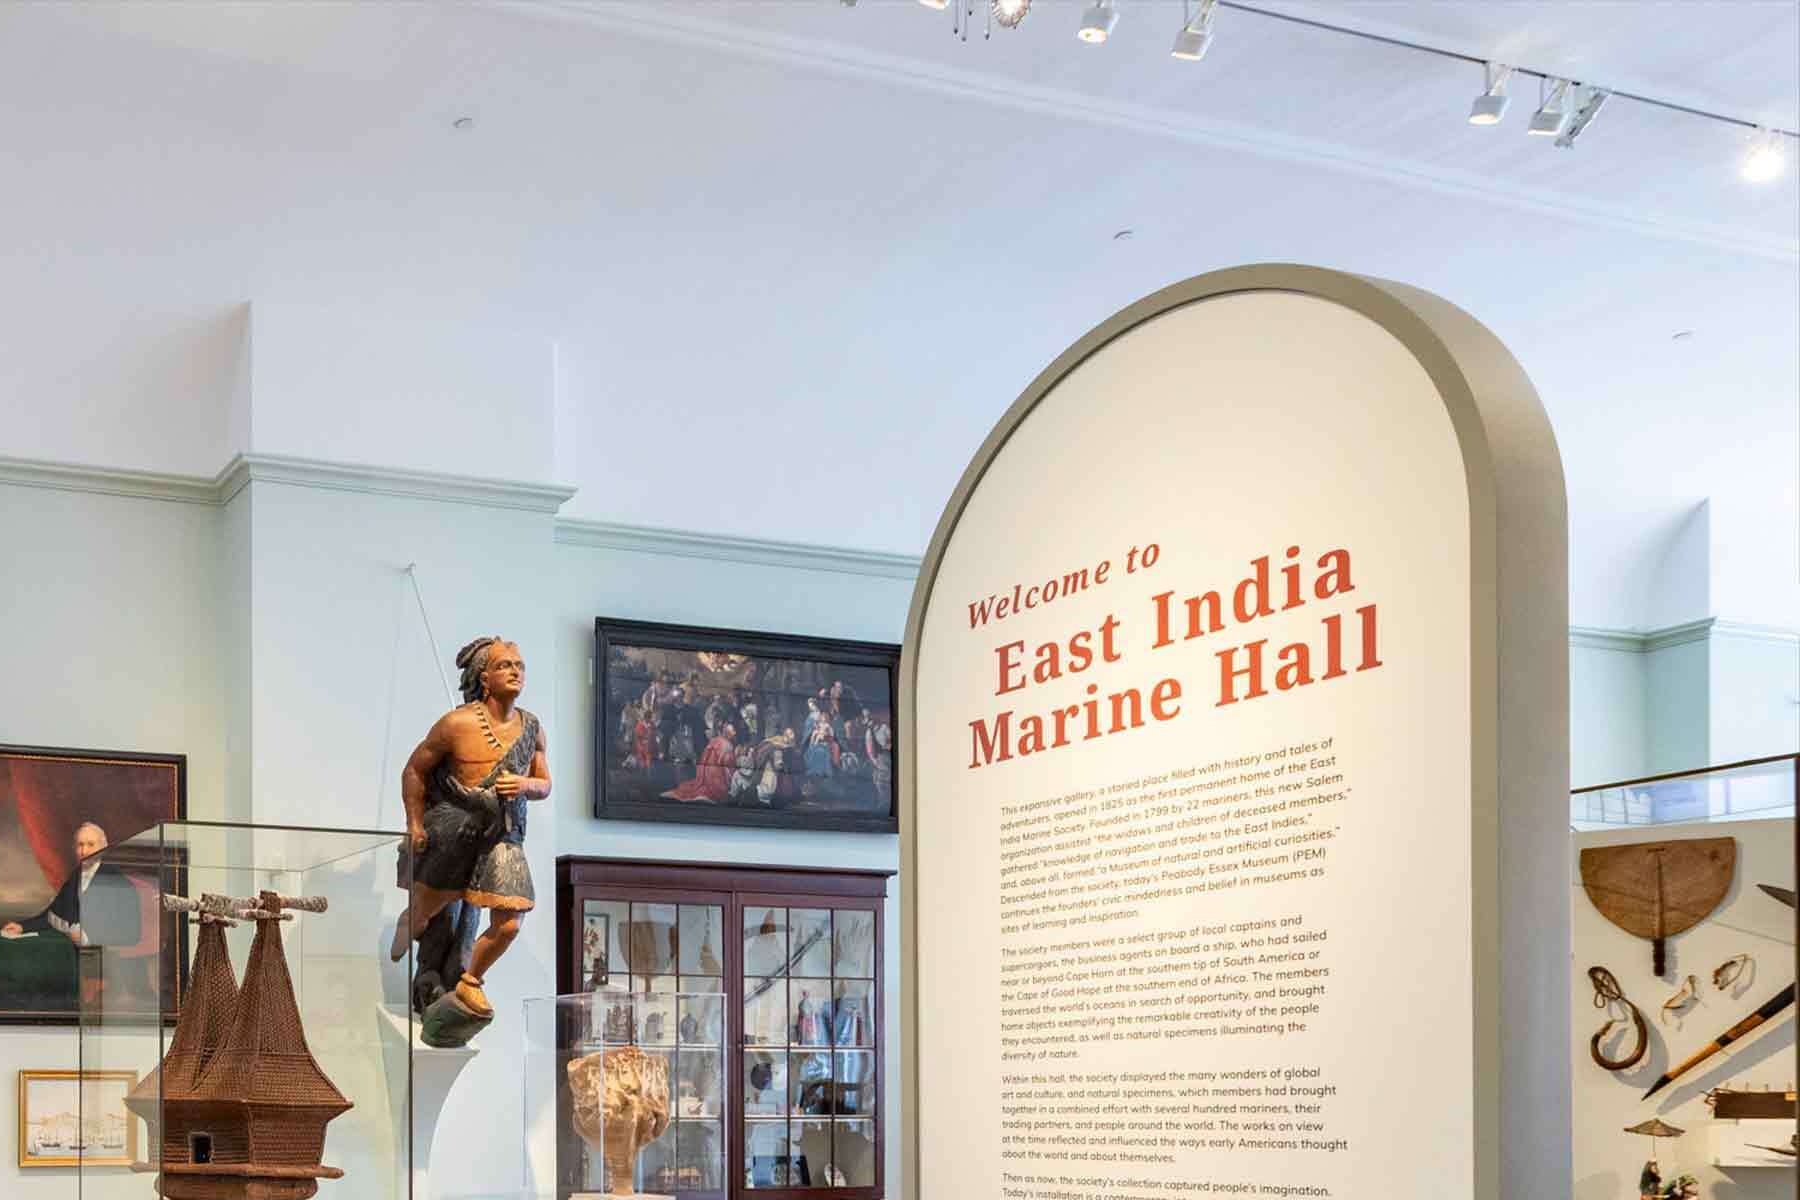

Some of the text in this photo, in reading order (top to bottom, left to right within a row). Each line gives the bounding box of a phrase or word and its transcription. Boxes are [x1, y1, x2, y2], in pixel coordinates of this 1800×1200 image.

[968, 543, 1160, 629] Welcome to
[994, 544, 1356, 697] East India
[967, 603, 1383, 769] Marine Hall
[1264, 747, 1286, 761] and
[1289, 742, 1318, 756] tales
[1320, 737, 1333, 749] of
[1239, 769, 1270, 783] home
[1273, 764, 1285, 776] of
[1287, 762, 1307, 774] the
[1309, 754, 1336, 769] East
[1254, 785, 1275, 798] this
[1277, 781, 1303, 793] new
[1305, 773, 1343, 788] Salem
[1232, 800, 1286, 819] deceased
[1243, 820, 1268, 834] East
[1241, 854, 1289, 869] Museum
[1252, 869, 1307, 884] museums
[1310, 867, 1325, 877] as
[1229, 919, 1277, 933] captains
[1279, 914, 1302, 926] and
[1239, 937, 1264, 948] who
[1266, 933, 1289, 945] had
[1292, 930, 1327, 943] sailed
[1257, 951, 1305, 964] America
[1307, 950, 1320, 959] or
[1251, 971, 1273, 981] The
[1275, 967, 1330, 979] members
[1253, 987, 1276, 998] and
[1278, 984, 1325, 997] brought
[1245, 1006, 1256, 1016] of
[1258, 1005, 1278, 1015] the
[1280, 1002, 1319, 1017] people
[1220, 1023, 1285, 1034] illuminating
[1287, 1021, 1307, 1031] the
[1168, 1070, 1185, 1080] the
[1187, 1071, 1217, 1081] many
[1219, 1069, 1267, 1079] wonders
[1269, 1068, 1281, 1078] of
[1284, 1067, 1320, 1080] global
[1177, 1087, 1209, 1096] which
[1211, 1086, 1262, 1096] members
[1264, 1085, 1287, 1095] had
[1289, 1085, 1336, 1097] brought
[1154, 1103, 1190, 1113] several
[1192, 1103, 1237, 1113] hundred
[1294, 1103, 1322, 1113] their
[1165, 1120, 1181, 1129] the
[1218, 1120, 1239, 1130] The
[1241, 1120, 1275, 1130] works
[1277, 1122, 1293, 1130] on
[1295, 1121, 1324, 1130] view
[1159, 1136, 1176, 1146] the
[1178, 1138, 1206, 1149] ways
[1208, 1137, 1236, 1149] early
[1238, 1138, 1298, 1148] Americans
[1300, 1139, 1348, 1152] thought
[1164, 1180, 1210, 1191] captured
